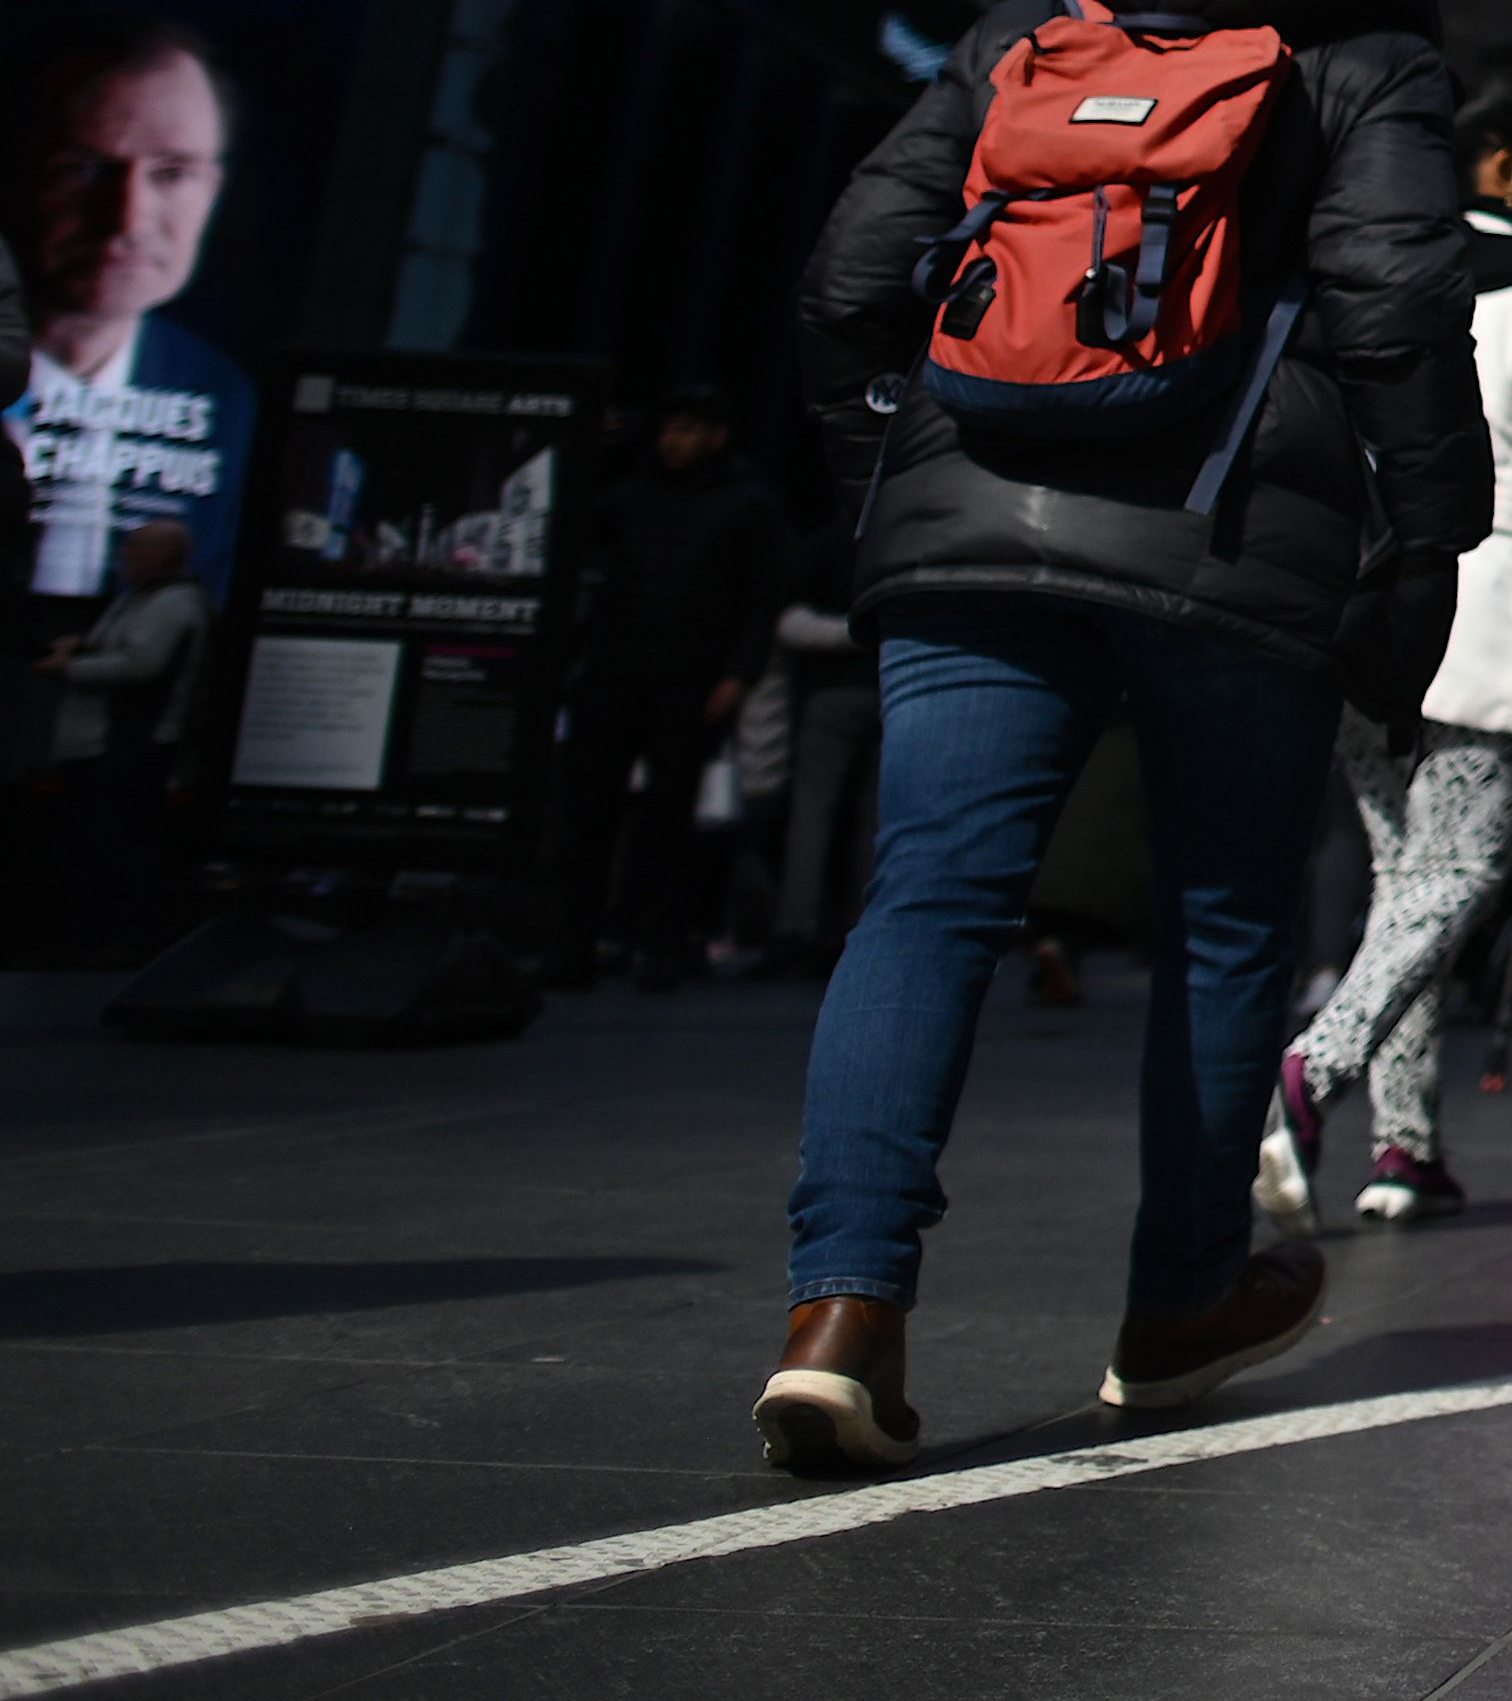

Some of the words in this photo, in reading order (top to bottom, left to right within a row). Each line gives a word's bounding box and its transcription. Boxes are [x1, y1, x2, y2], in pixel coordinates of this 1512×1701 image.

[34, 387, 216, 444] JACQUES
[24, 429, 223, 499] CHAPPUIS
[260, 586, 405, 618] MIDNIGHT
[408, 593, 544, 625] MOMENT
